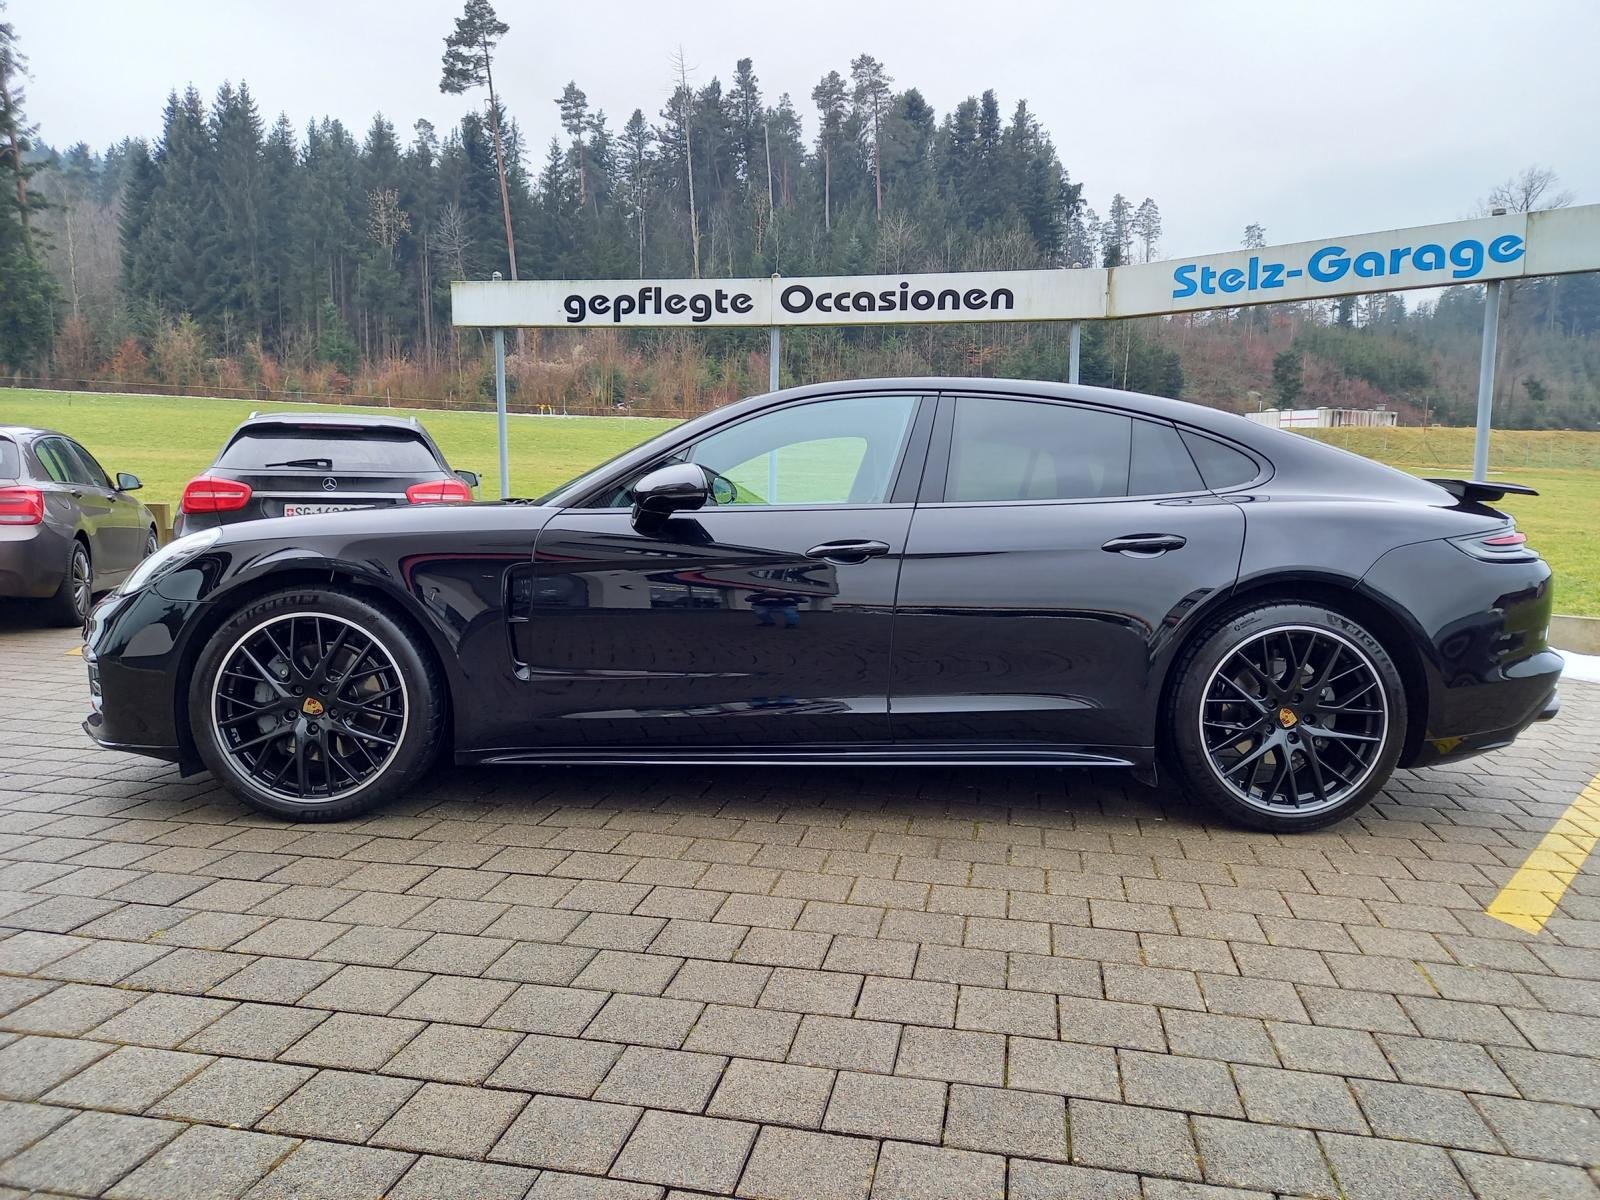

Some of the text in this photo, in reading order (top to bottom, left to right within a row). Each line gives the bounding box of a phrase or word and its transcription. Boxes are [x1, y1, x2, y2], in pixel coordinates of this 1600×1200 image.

[1172, 233, 1526, 299] Stelz-Garage
[563, 281, 1015, 324] gepflegte Occasionen
